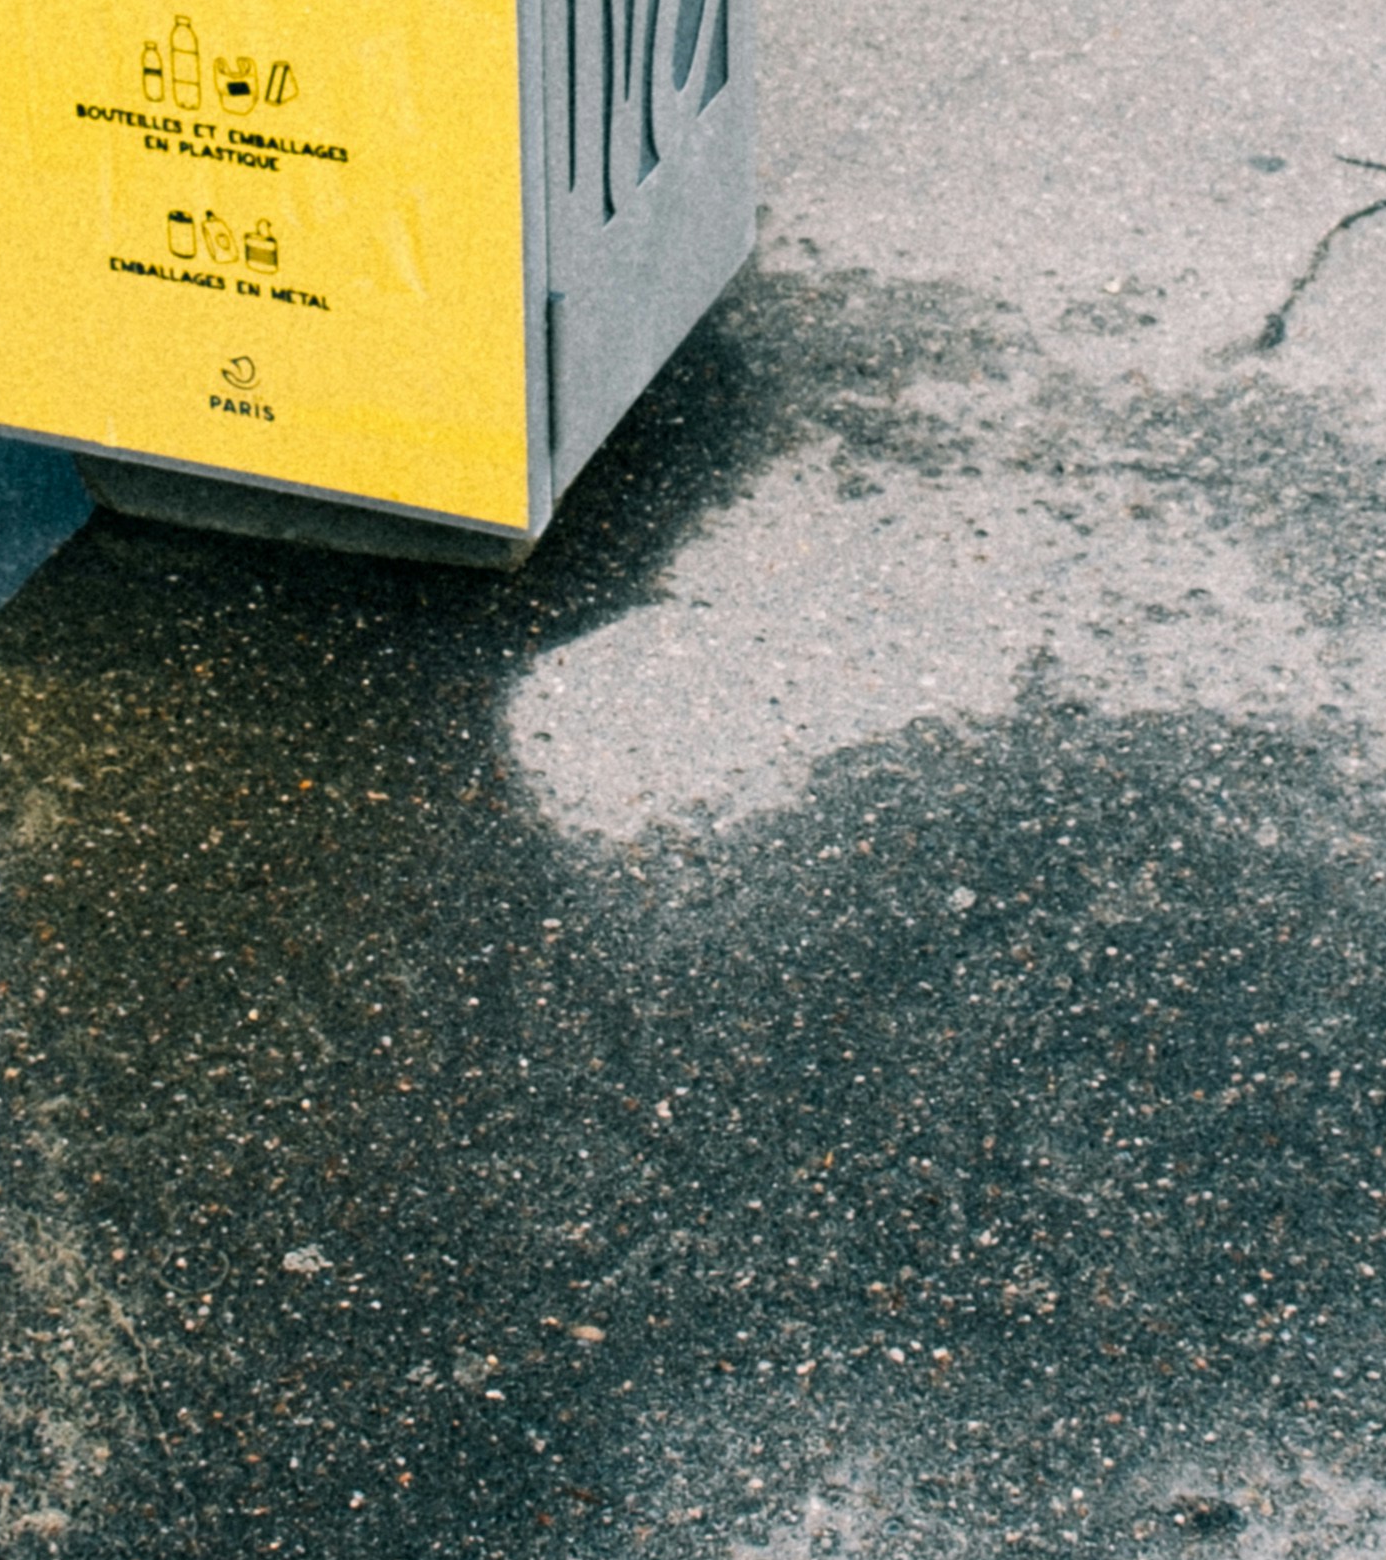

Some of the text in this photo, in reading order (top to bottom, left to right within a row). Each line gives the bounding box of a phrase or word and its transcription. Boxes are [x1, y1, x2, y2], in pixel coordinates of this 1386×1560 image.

[75, 103, 348, 163] BOUTEILLES ET EMBALLAGES
[144, 134, 278, 172] EN PLASTIQUE
[109, 256, 226, 291] EMBALLAGES
[236, 280, 261, 297] EN
[209, 394, 276, 423] PARIS
